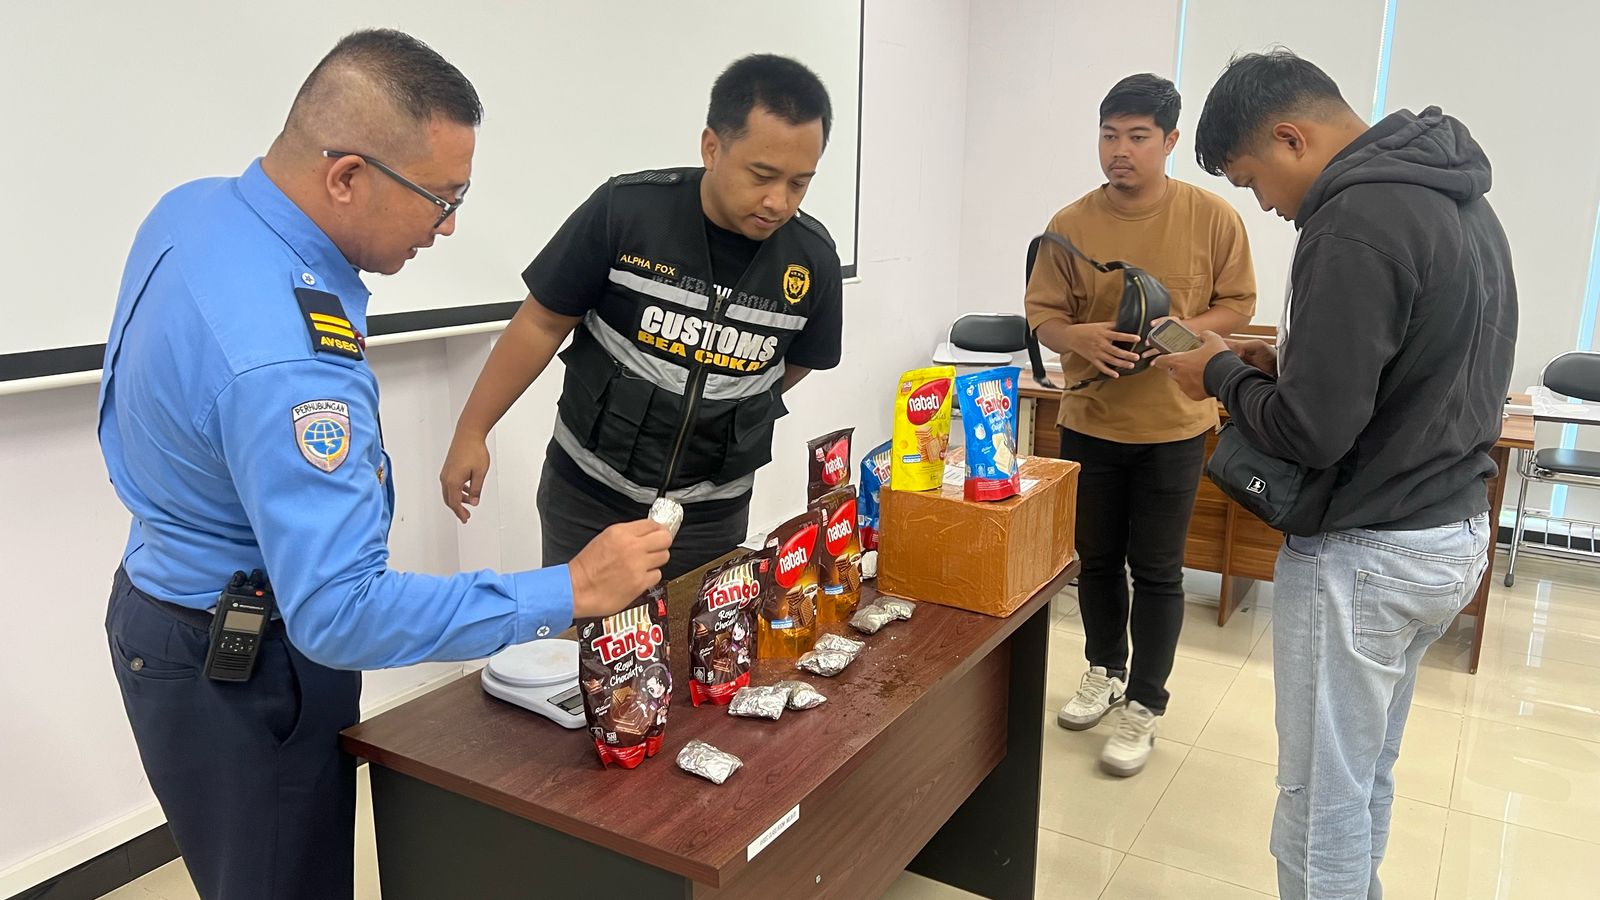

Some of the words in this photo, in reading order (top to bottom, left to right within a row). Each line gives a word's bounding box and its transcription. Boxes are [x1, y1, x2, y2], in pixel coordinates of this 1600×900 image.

[619, 253, 651, 270] ALPHA
[654, 262, 676, 277] FOX
[320, 335, 359, 353] AVSEC
[637, 329, 687, 357] BEA
[640, 305, 778, 362] CUSTOMS
[294, 401, 345, 416] PERHUBUNGAN
[908, 393, 940, 412] nabati
[873, 463, 891, 484] Tan
[827, 518, 852, 543] nabati
[779, 546, 808, 574] nabati
[704, 580, 760, 611] Tango
[591, 624, 663, 664] Tango
[609, 664, 644, 687] Chocolate
[613, 656, 634, 673] Royal
